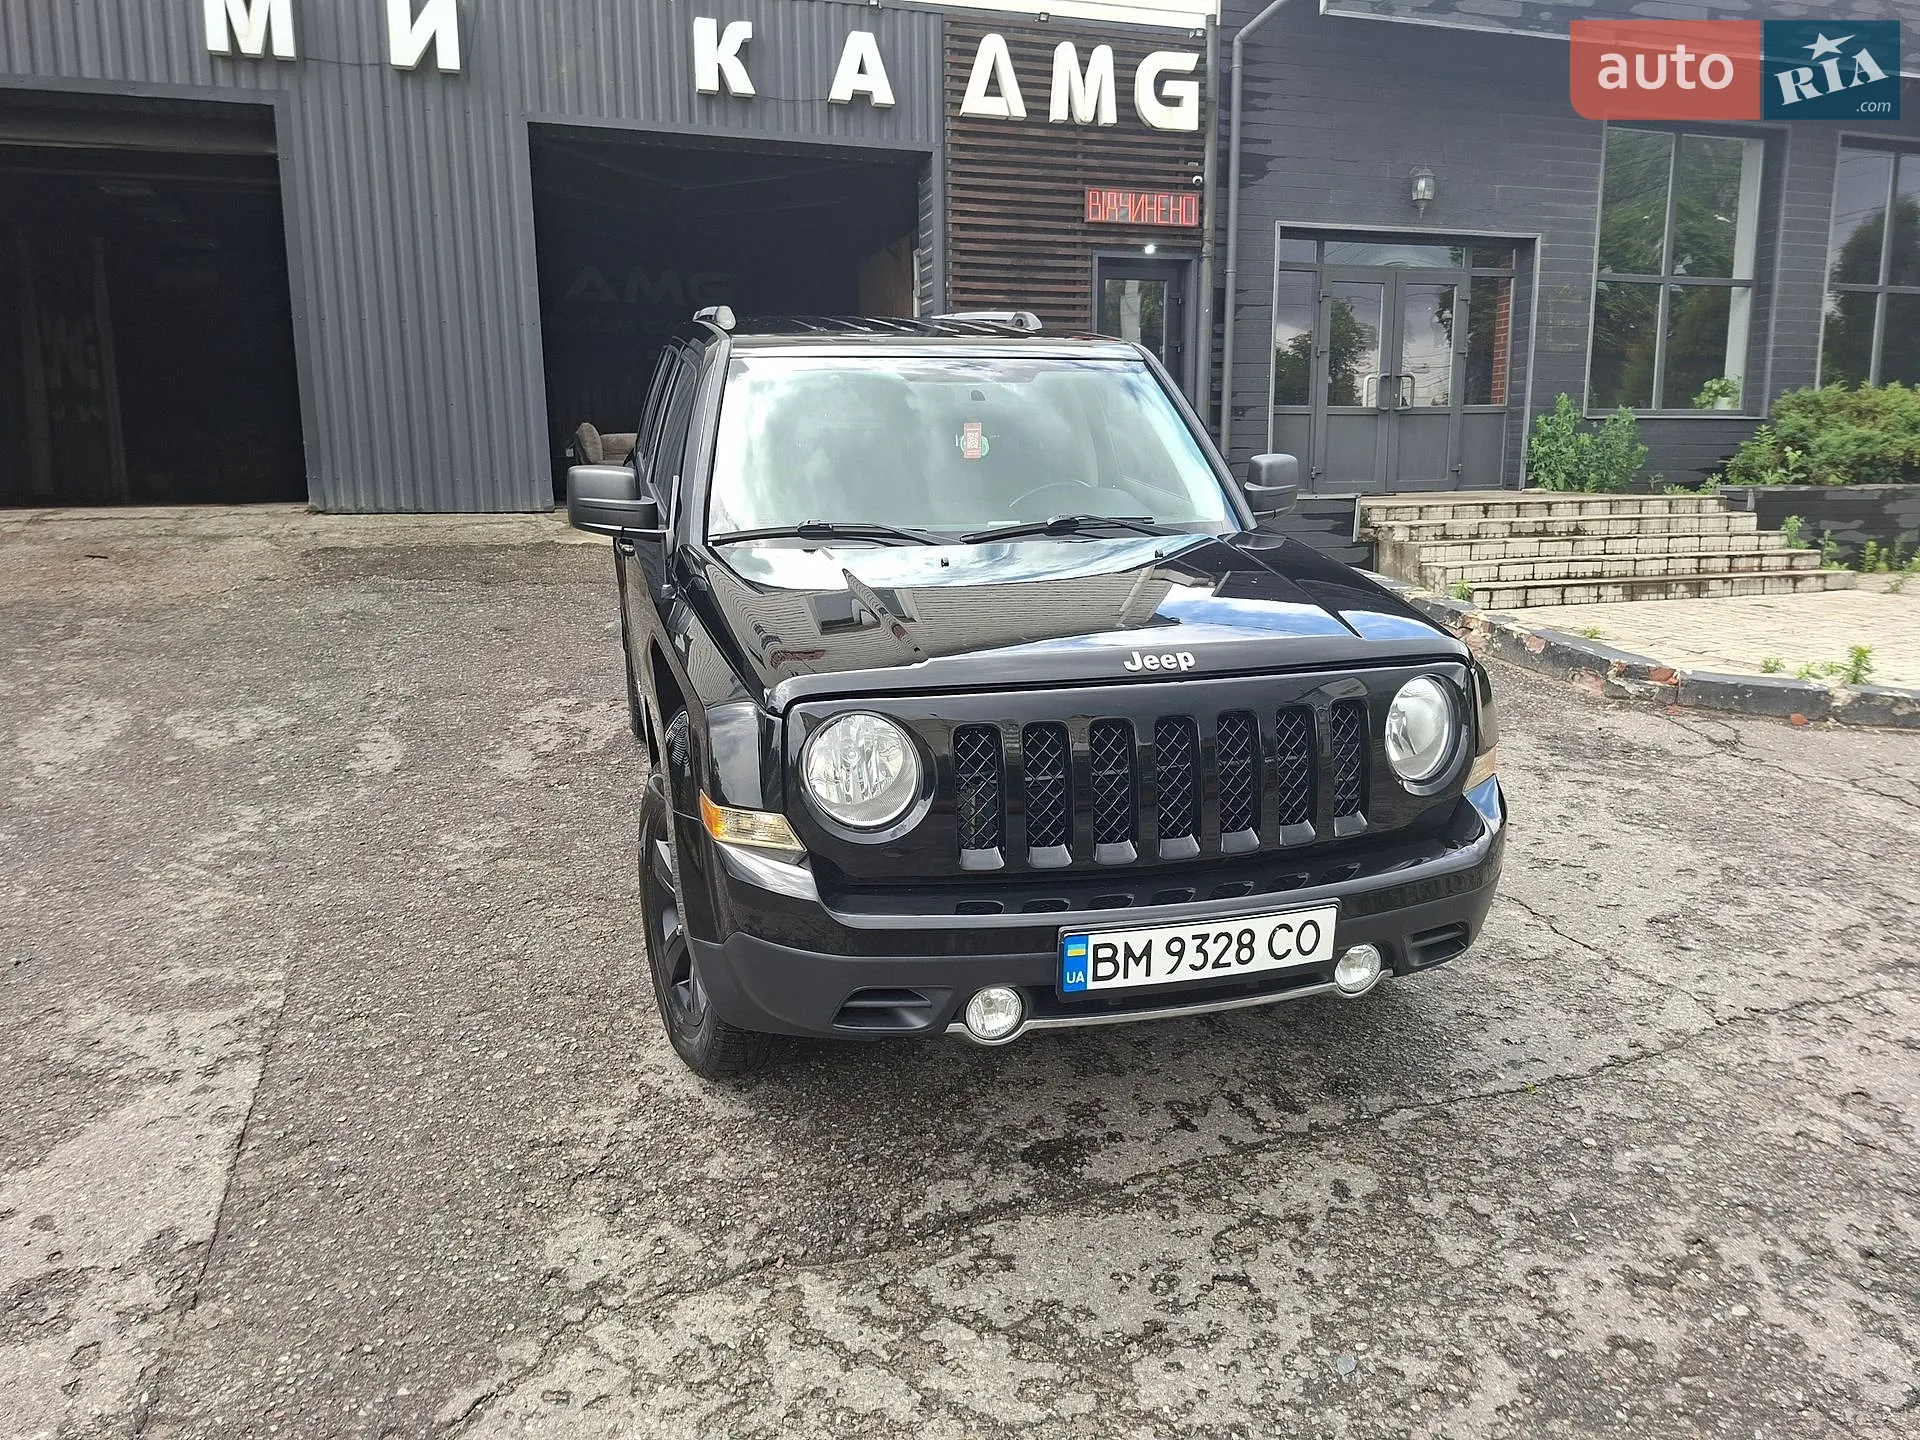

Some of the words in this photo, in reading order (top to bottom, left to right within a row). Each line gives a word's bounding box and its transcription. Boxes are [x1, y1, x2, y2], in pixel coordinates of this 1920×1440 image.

[959, 33, 1200, 132] AMG
[1089, 190, 1196, 226] ВІДЧИНЕНО
[1123, 651, 1196, 672] Jeep
[1091, 938, 1154, 983] BM
[1165, 928, 1256, 976] 9328
[1267, 919, 1321, 961] CO
[1066, 971, 1086, 985] UA
